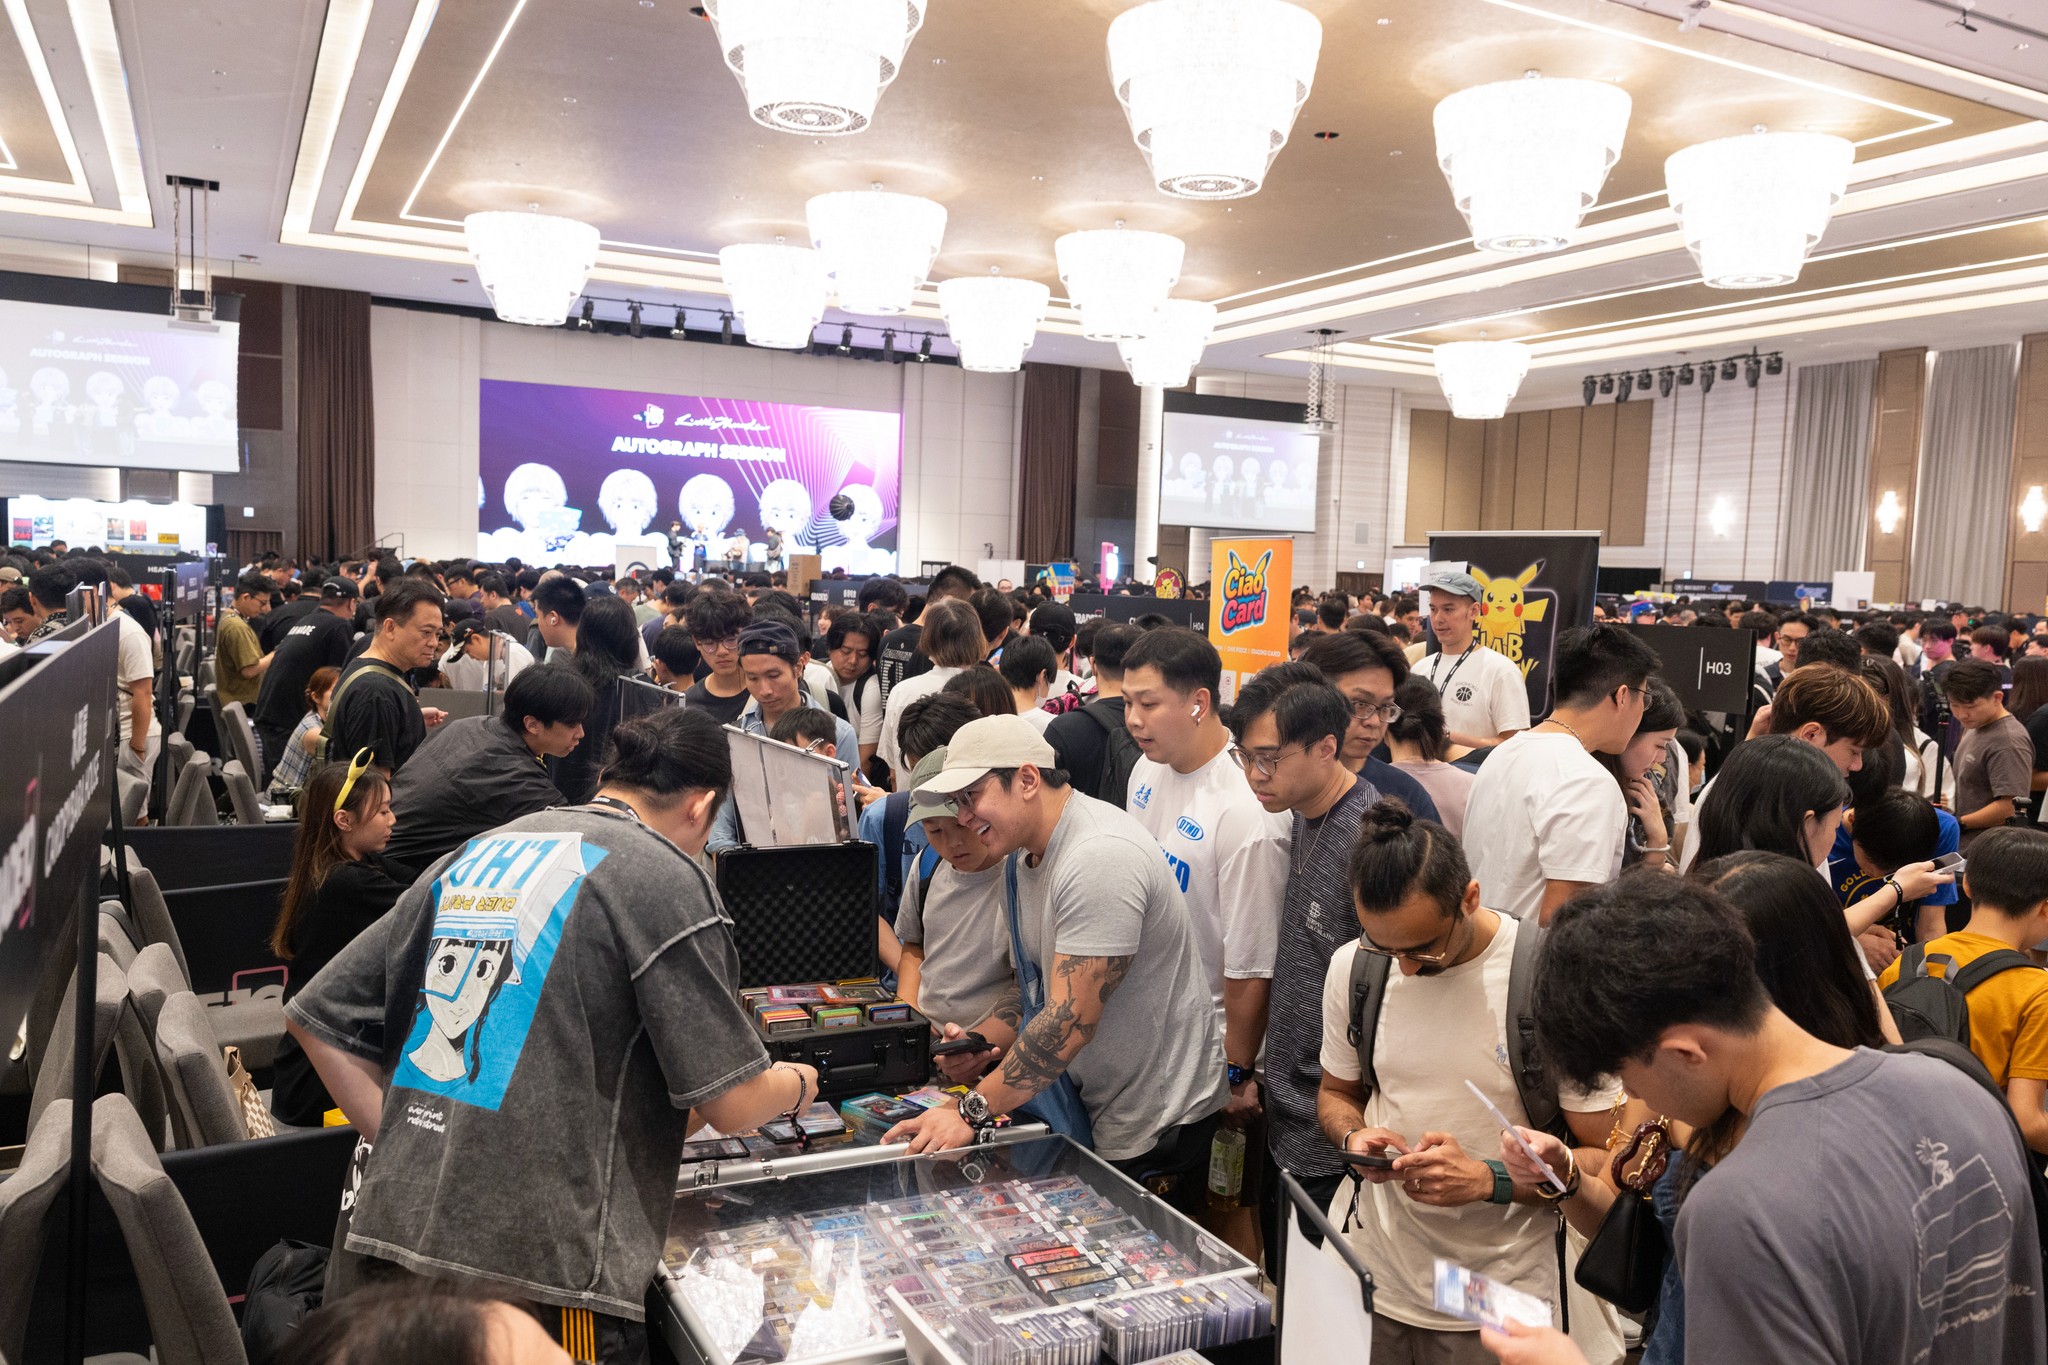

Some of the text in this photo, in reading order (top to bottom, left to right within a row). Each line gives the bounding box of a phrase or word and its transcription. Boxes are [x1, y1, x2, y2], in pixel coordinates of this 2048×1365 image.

[611, 436, 787, 463] AUTOGRAPH SESSION
[1224, 567, 1264, 600] Ciao
[1222, 591, 1266, 631] Card
[1706, 661, 1732, 676] H03
[1840, 867, 1867, 892] GOLD
